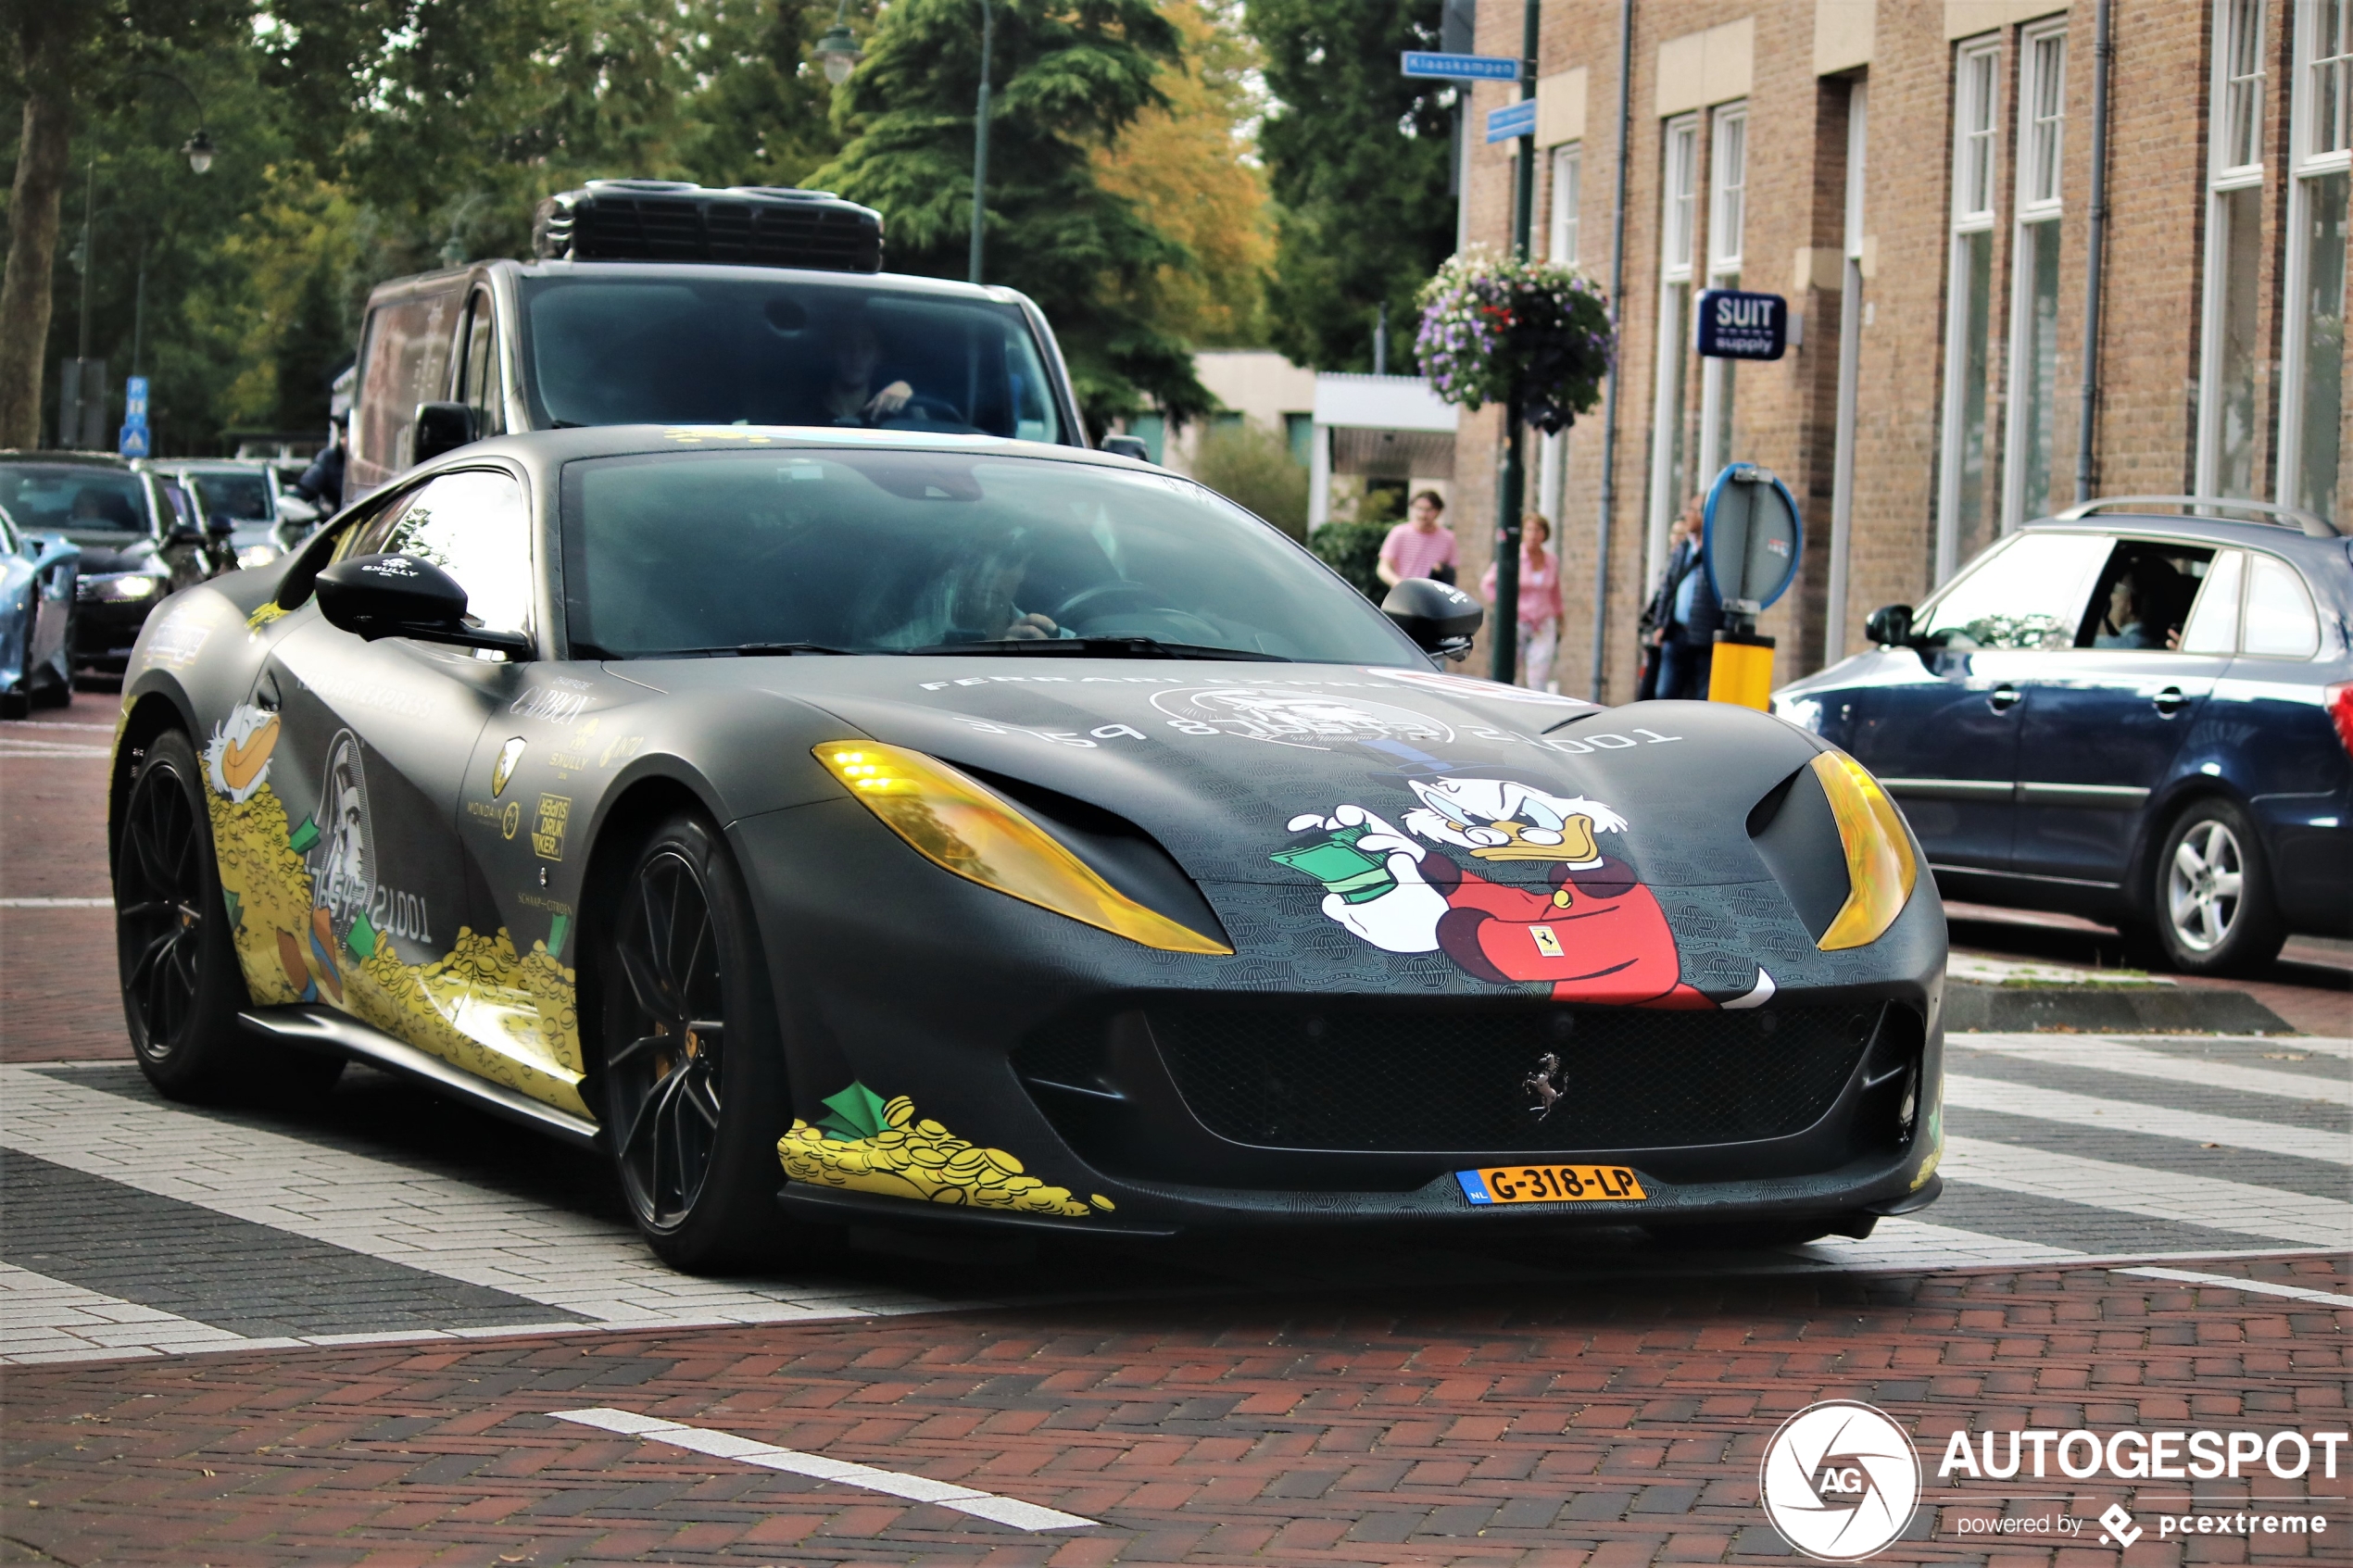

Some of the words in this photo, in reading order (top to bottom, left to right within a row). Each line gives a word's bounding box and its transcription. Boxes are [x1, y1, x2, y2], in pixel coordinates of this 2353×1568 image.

[1717, 296, 1775, 327] SUIT
[1716, 337, 1773, 356] supply
[361, 565, 419, 577] SKULLY
[918, 675, 1185, 692] FERRARI
[548, 751, 589, 771] SKULLY
[541, 816, 564, 838] DRUK
[371, 884, 432, 944] 21001
[1491, 1168, 1634, 1200] G-318-LP
[1470, 1191, 1489, 1200] NL
